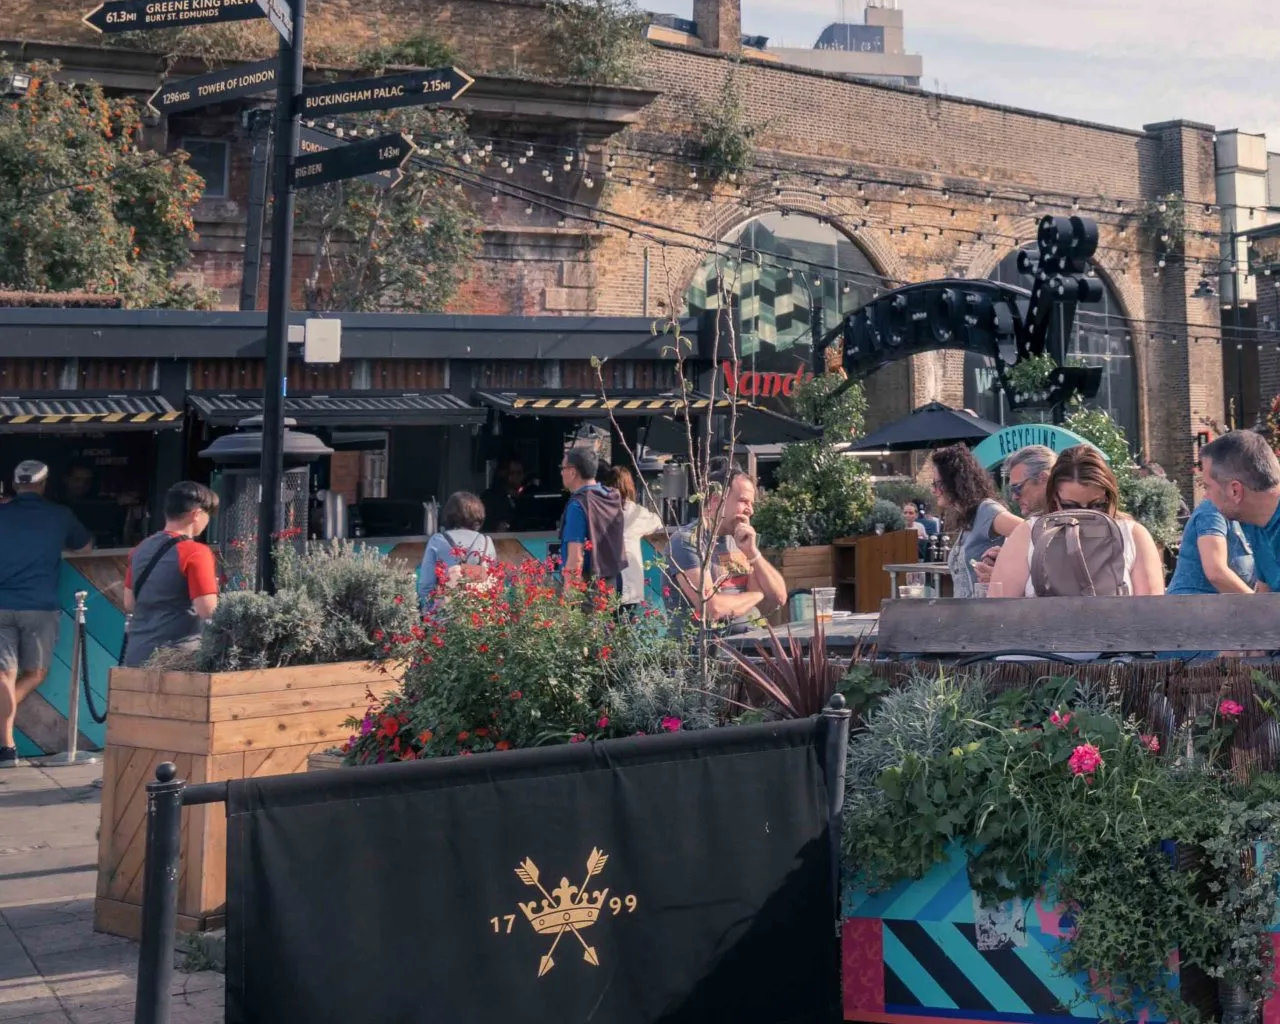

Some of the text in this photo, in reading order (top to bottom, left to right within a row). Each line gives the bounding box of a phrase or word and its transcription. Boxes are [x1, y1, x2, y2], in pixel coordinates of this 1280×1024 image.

[145, 1, 190, 14] GREENE
[145, 8, 219, 23] BURY ST. EDMUNDS
[197, 69, 275, 97] TOWER OF LONDON
[306, 90, 372, 108] BUCKINGHAM
[999, 428, 1057, 455] RECYCLING
[609, 894, 637, 915] 99
[490, 914, 516, 934] 17
